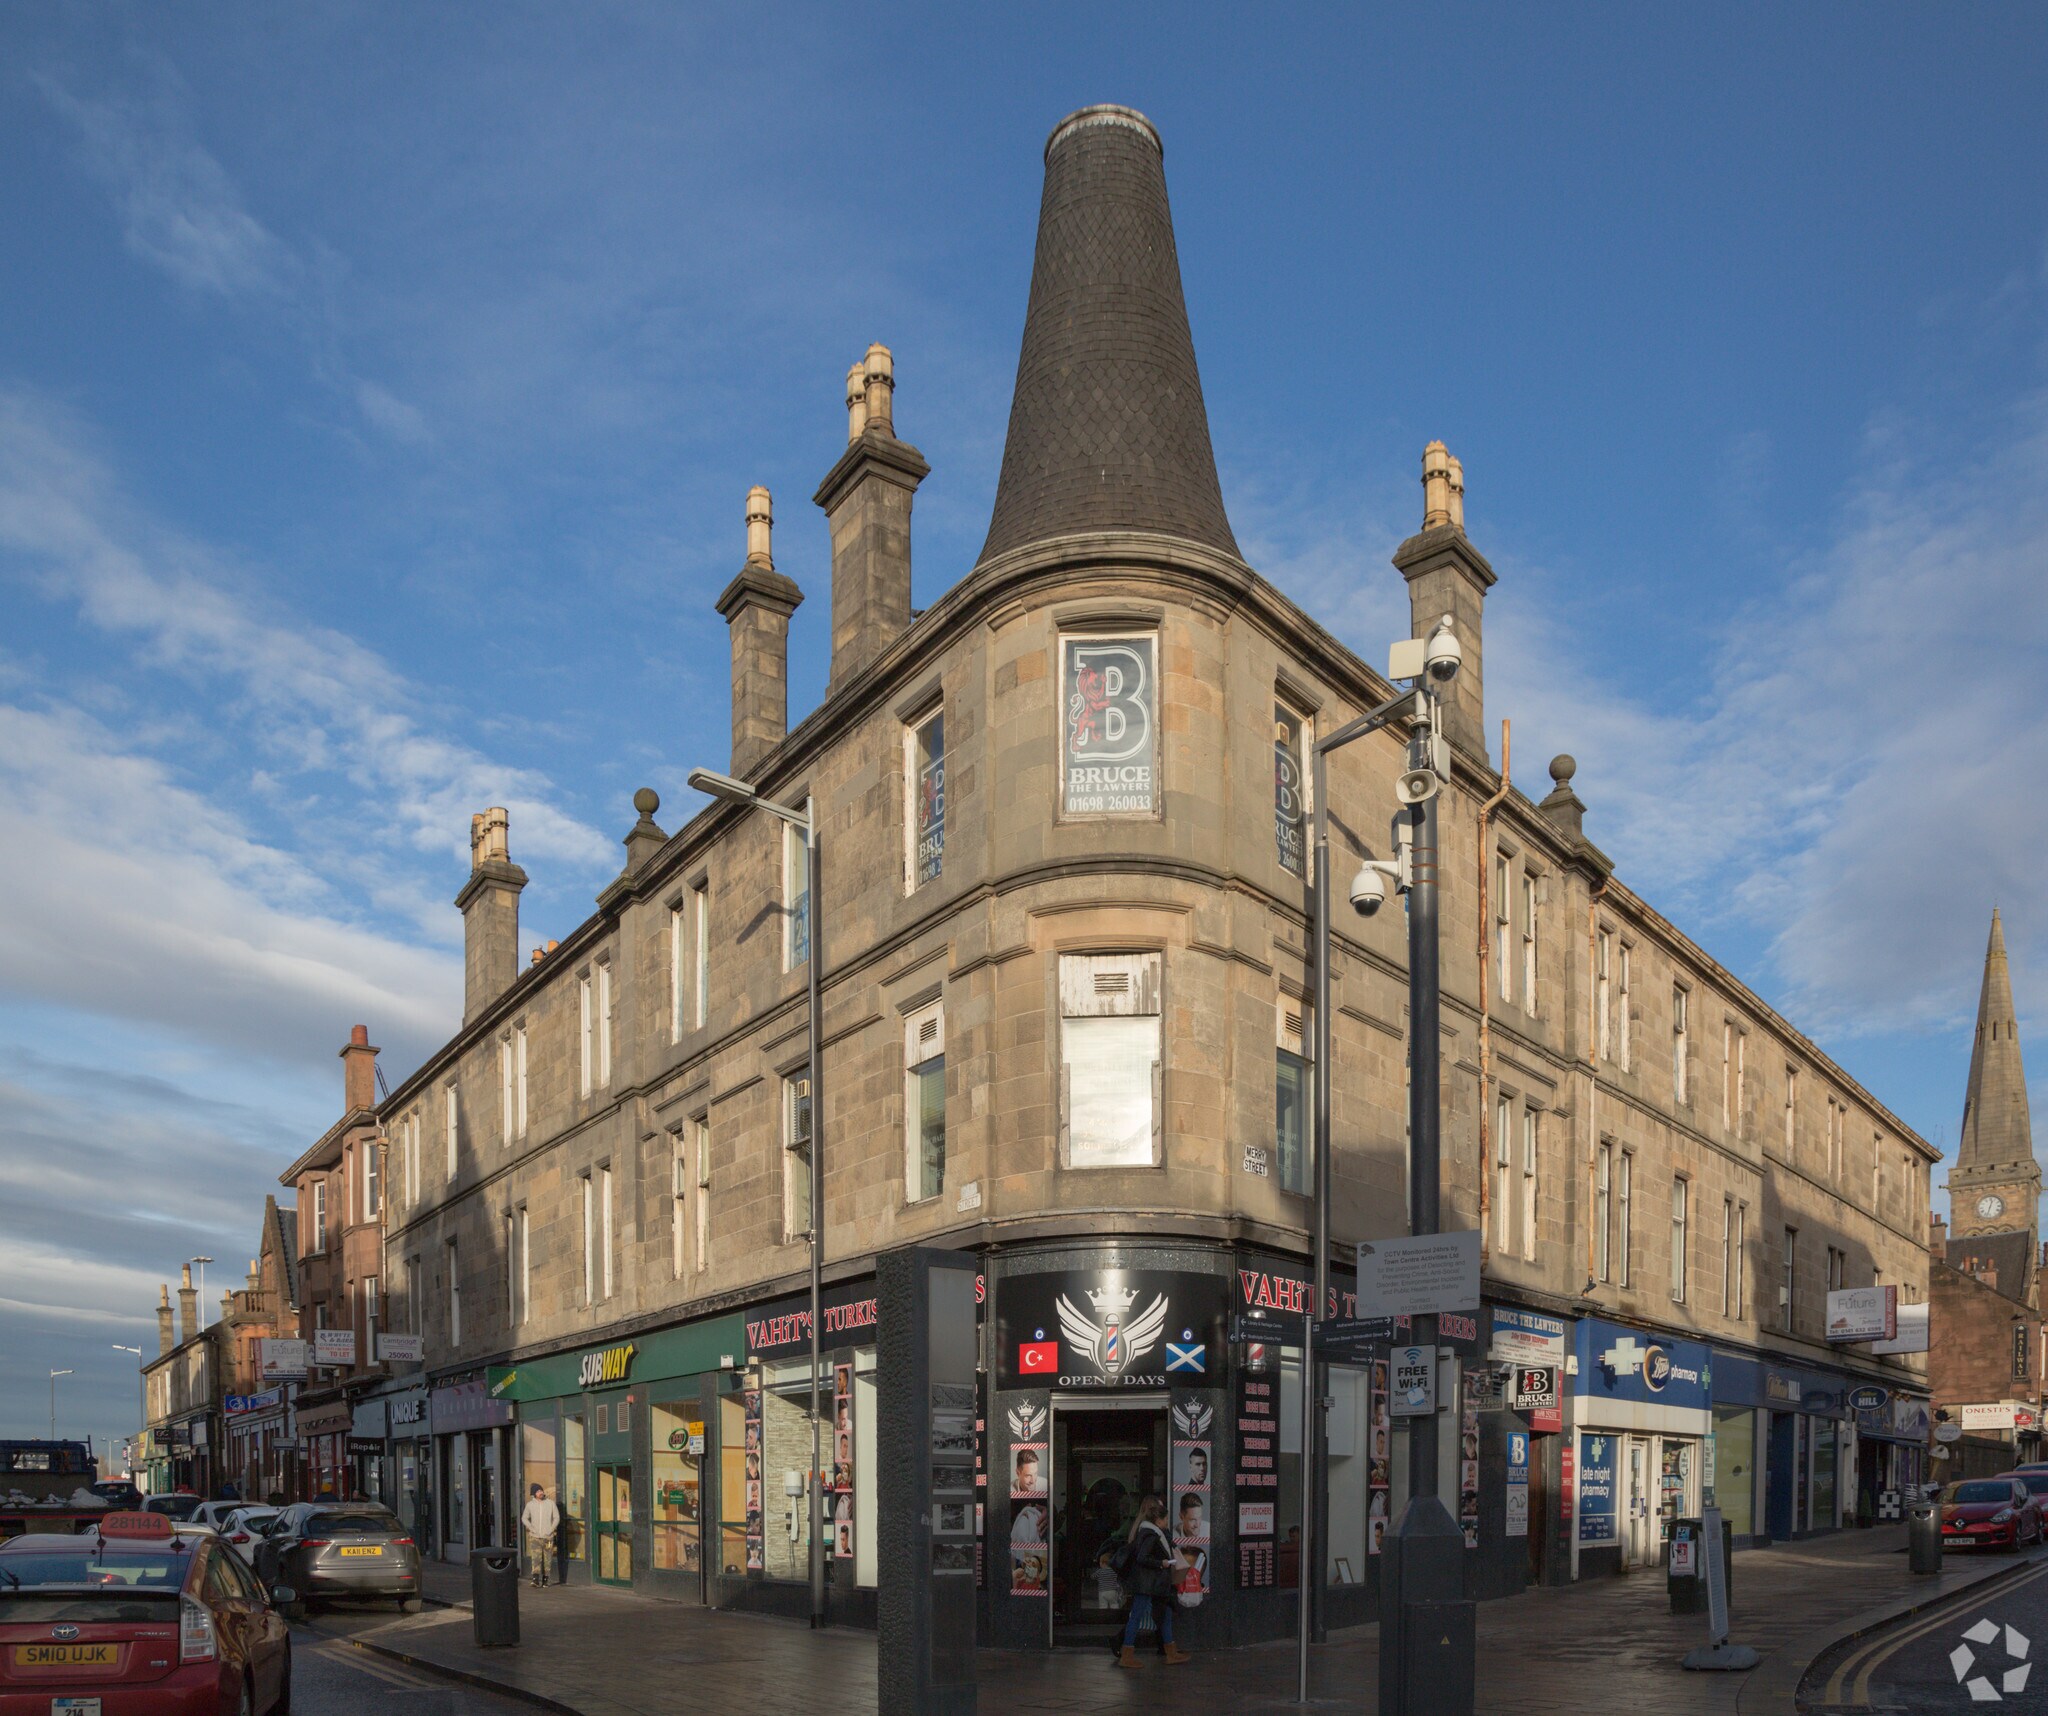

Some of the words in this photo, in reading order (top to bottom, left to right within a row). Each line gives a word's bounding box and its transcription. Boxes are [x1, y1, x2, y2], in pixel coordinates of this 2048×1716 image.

[1070, 766, 1150, 784] BRUCE
[1070, 784, 1092, 792] THE
[1096, 782, 1149, 792] LAWYERS
[1070, 797, 1103, 811] 01698
[1108, 795, 1150, 810] 260033
[1245, 1160, 1265, 1175] STREET
[1402, 1248, 1431, 1256] Monitored
[1421, 1254, 1448, 1262] Activities
[1395, 1264, 1420, 1273] purposes
[1428, 1261, 1454, 1269] Detecting
[1402, 1277, 1439, 1286] Environmental
[1441, 1283, 1458, 1291] Safety
[1838, 1298, 1877, 1309] Future
[824, 1298, 877, 1332] TURKIS
[1494, 1309, 1518, 1325] BRUCE
[1519, 1314, 1533, 1329] THE
[1534, 1317, 1564, 1334] LAWYERS
[388, 1351, 413, 1360] 250903
[2017, 1333, 2025, 1376] RAILWAY
[579, 1344, 634, 1386] SUBWAY
[1398, 1366, 1428, 1377] FREE
[1671, 1366, 1698, 1384] pharmacy
[491, 1370, 517, 1397] SUBWAY
[1058, 1375, 1106, 1386] OPEN
[1112, 1376, 1119, 1385] 7
[1123, 1375, 1165, 1385] DAYS
[1399, 1378, 1427, 1388] Wi-Fi
[1788, 1380, 1801, 1401] HILL
[1518, 1393, 1552, 1403] BRUCE
[1858, 1397, 1878, 1406] HILL
[391, 1401, 420, 1424] UNIQUE
[1965, 1406, 2011, 1414] ONESTI'S
[1508, 1467, 1528, 1476] BRUCE
[1581, 1466, 1594, 1480] late
[1595, 1466, 1611, 1482] night
[1581, 1484, 1610, 1499] pharmacy
[1241, 1507, 1251, 1516] GIFT
[1251, 1507, 1272, 1516] VOUCHERS
[110, 1517, 161, 1529] 281144
[1246, 1521, 1267, 1531] AVAILABLE
[27, 1647, 67, 1662] SM10
[71, 1647, 107, 1661] UJK
